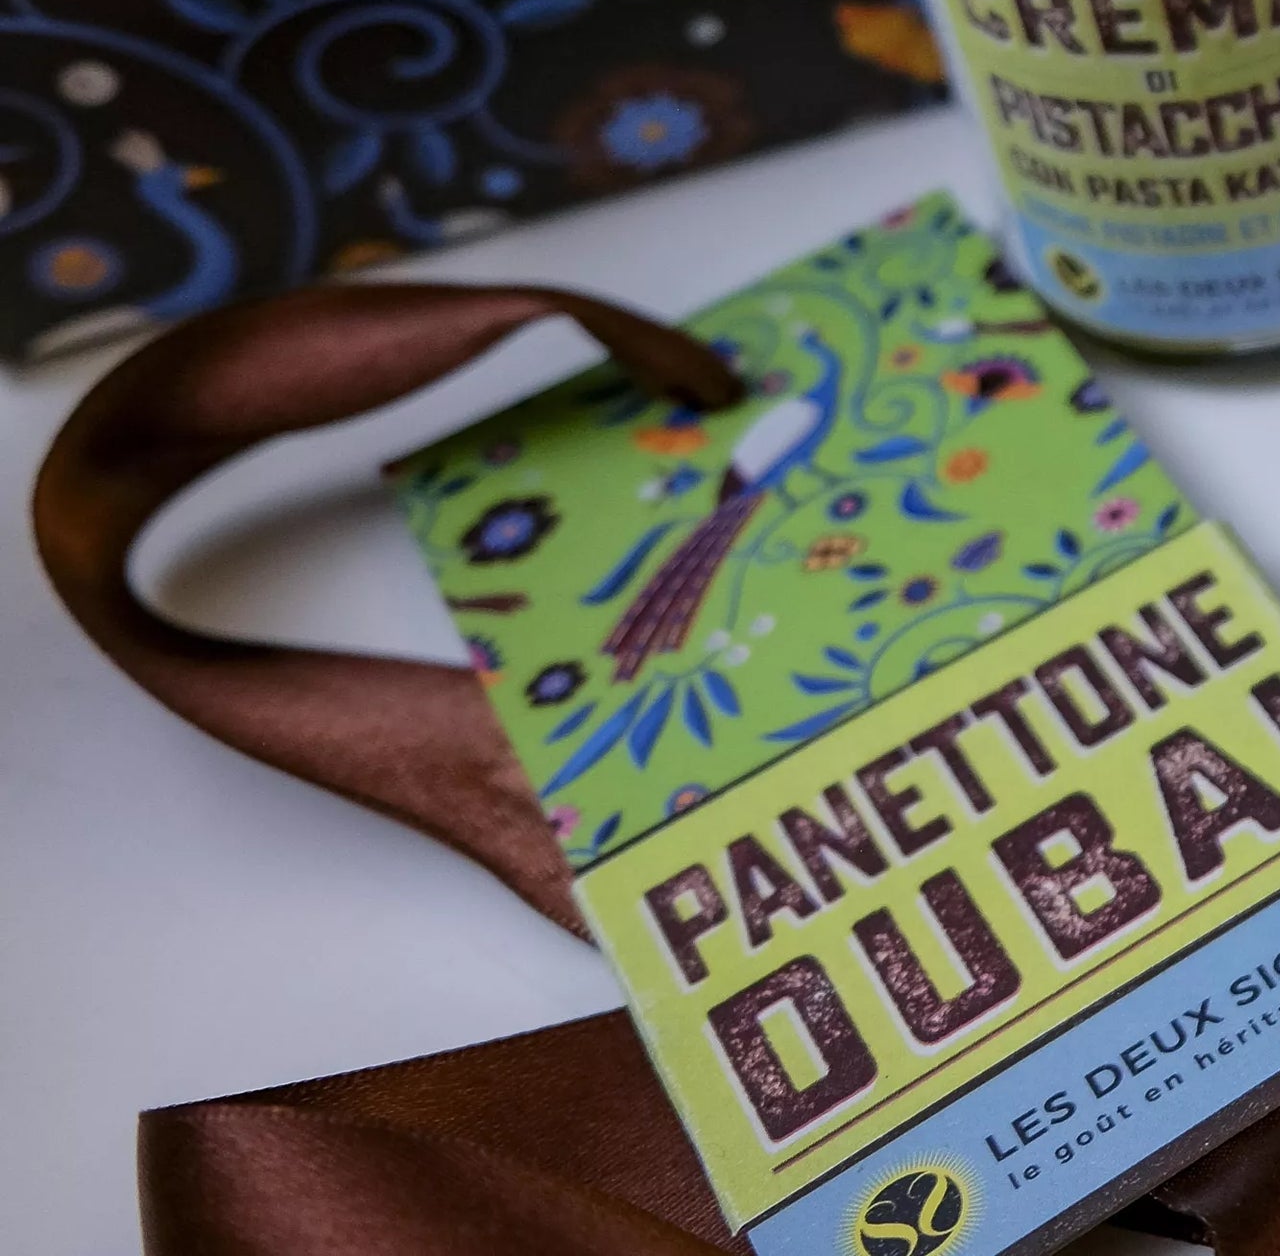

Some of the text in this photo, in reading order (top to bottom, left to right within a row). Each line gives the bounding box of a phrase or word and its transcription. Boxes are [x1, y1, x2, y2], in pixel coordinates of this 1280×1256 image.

[1144, 70, 1178, 94] DI
[1086, 174, 1215, 208] PASTA
[643, 569, 1266, 985] PANETTONE
[984, 1090, 1077, 1163] LES
[1084, 997, 1225, 1099] DEUX
[1007, 1163, 1042, 1190] le
[1054, 1103, 1133, 1165] goût
[1144, 1072, 1184, 1103] en
